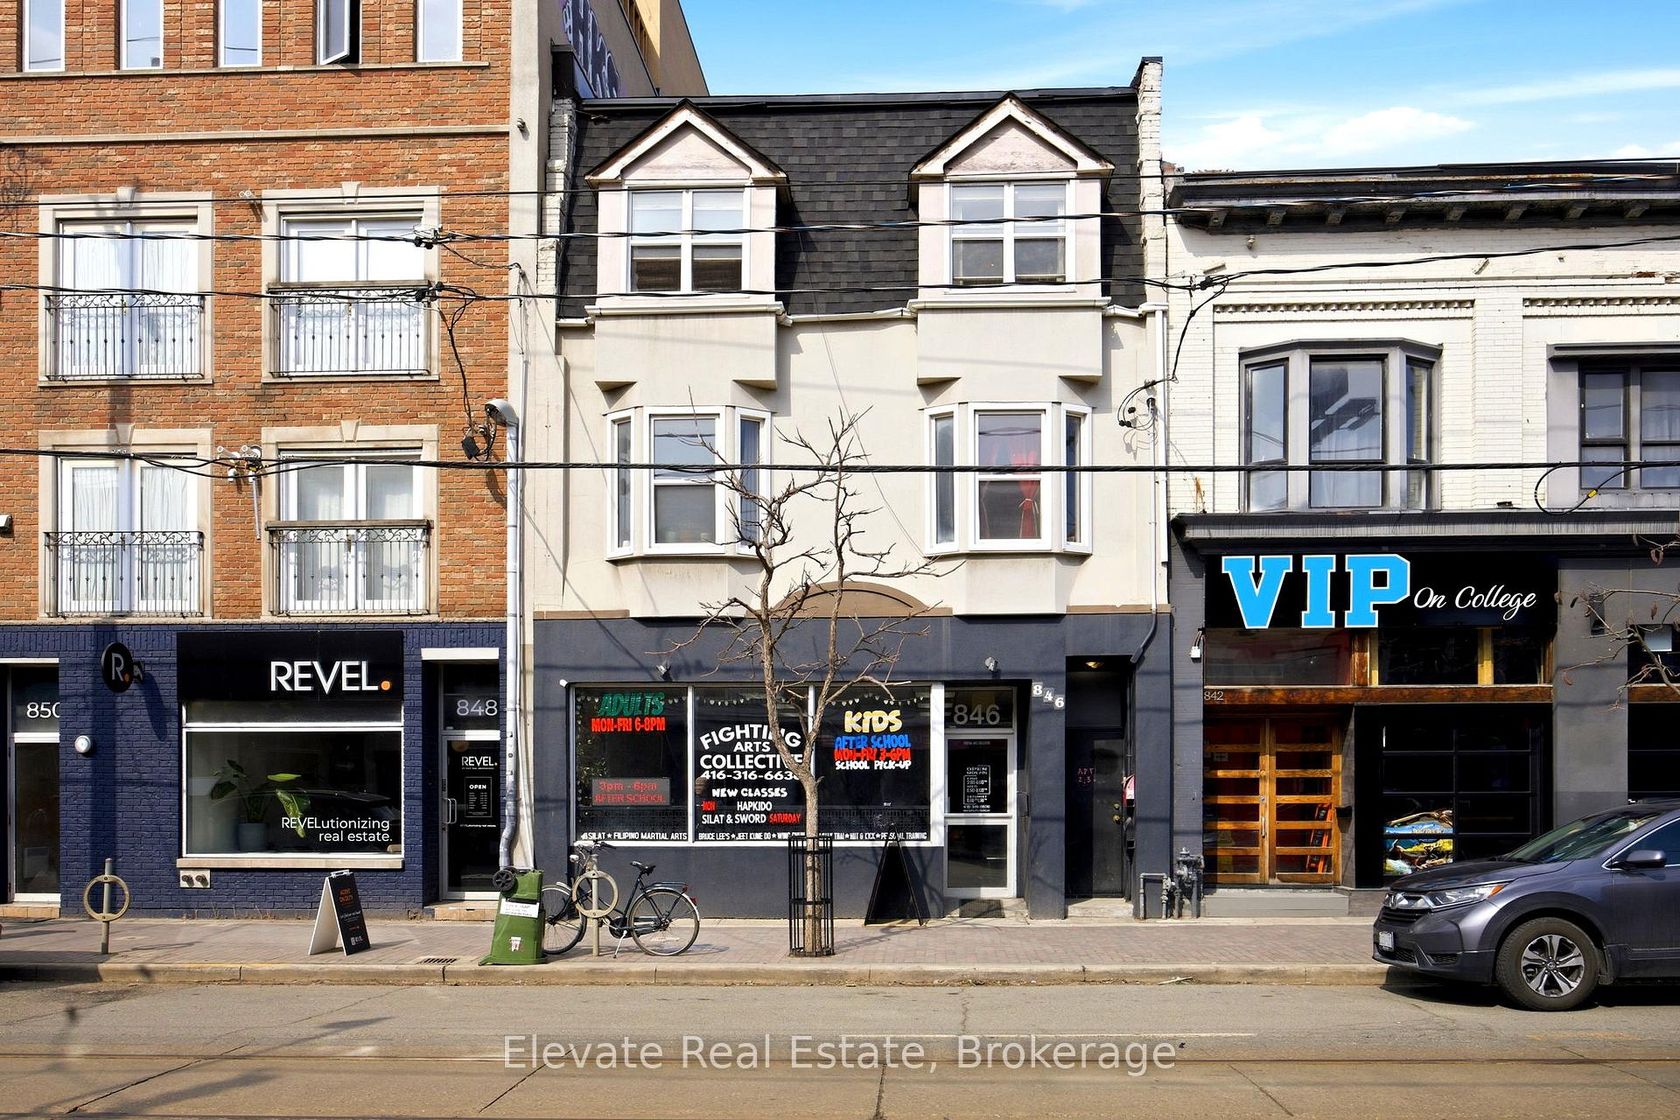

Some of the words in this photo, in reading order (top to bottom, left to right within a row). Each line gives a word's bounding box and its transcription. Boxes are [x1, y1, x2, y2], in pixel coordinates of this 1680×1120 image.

[1221, 553, 1411, 629] VIP
[1413, 587, 1446, 609] On
[1454, 585, 1537, 621] College
[1033, 684, 1065, 708] 846
[1203, 690, 1224, 701] 842
[456, 699, 498, 716] 848
[598, 692, 665, 717] ADULTS
[844, 709, 903, 733] KIDS
[953, 703, 1001, 725] 846
[591, 717, 633, 732] MON-FRI
[634, 716, 666, 732] 6-8PM
[733, 741, 771, 752] ARTS
[834, 736, 868, 750] AFTER
[870, 734, 912, 749] SCHOOL
[711, 788, 739, 798] NEW
[740, 788, 788, 798] CLASSES
[737, 801, 773, 812] HAPKIDO
[281, 817, 390, 832] REVELutionizing
[702, 814, 725, 824] SILAT
[726, 815, 734, 824] &
[735, 814, 767, 824] SWORD
[768, 813, 801, 824] SATURDAY
[319, 831, 344, 842] real
[347, 831, 393, 842] estate.
[613, 832, 640, 840] FILIPINO
[641, 832, 669, 840] MARTIAL
[670, 832, 688, 840] ARTS
[735, 832, 750, 840] JEET
